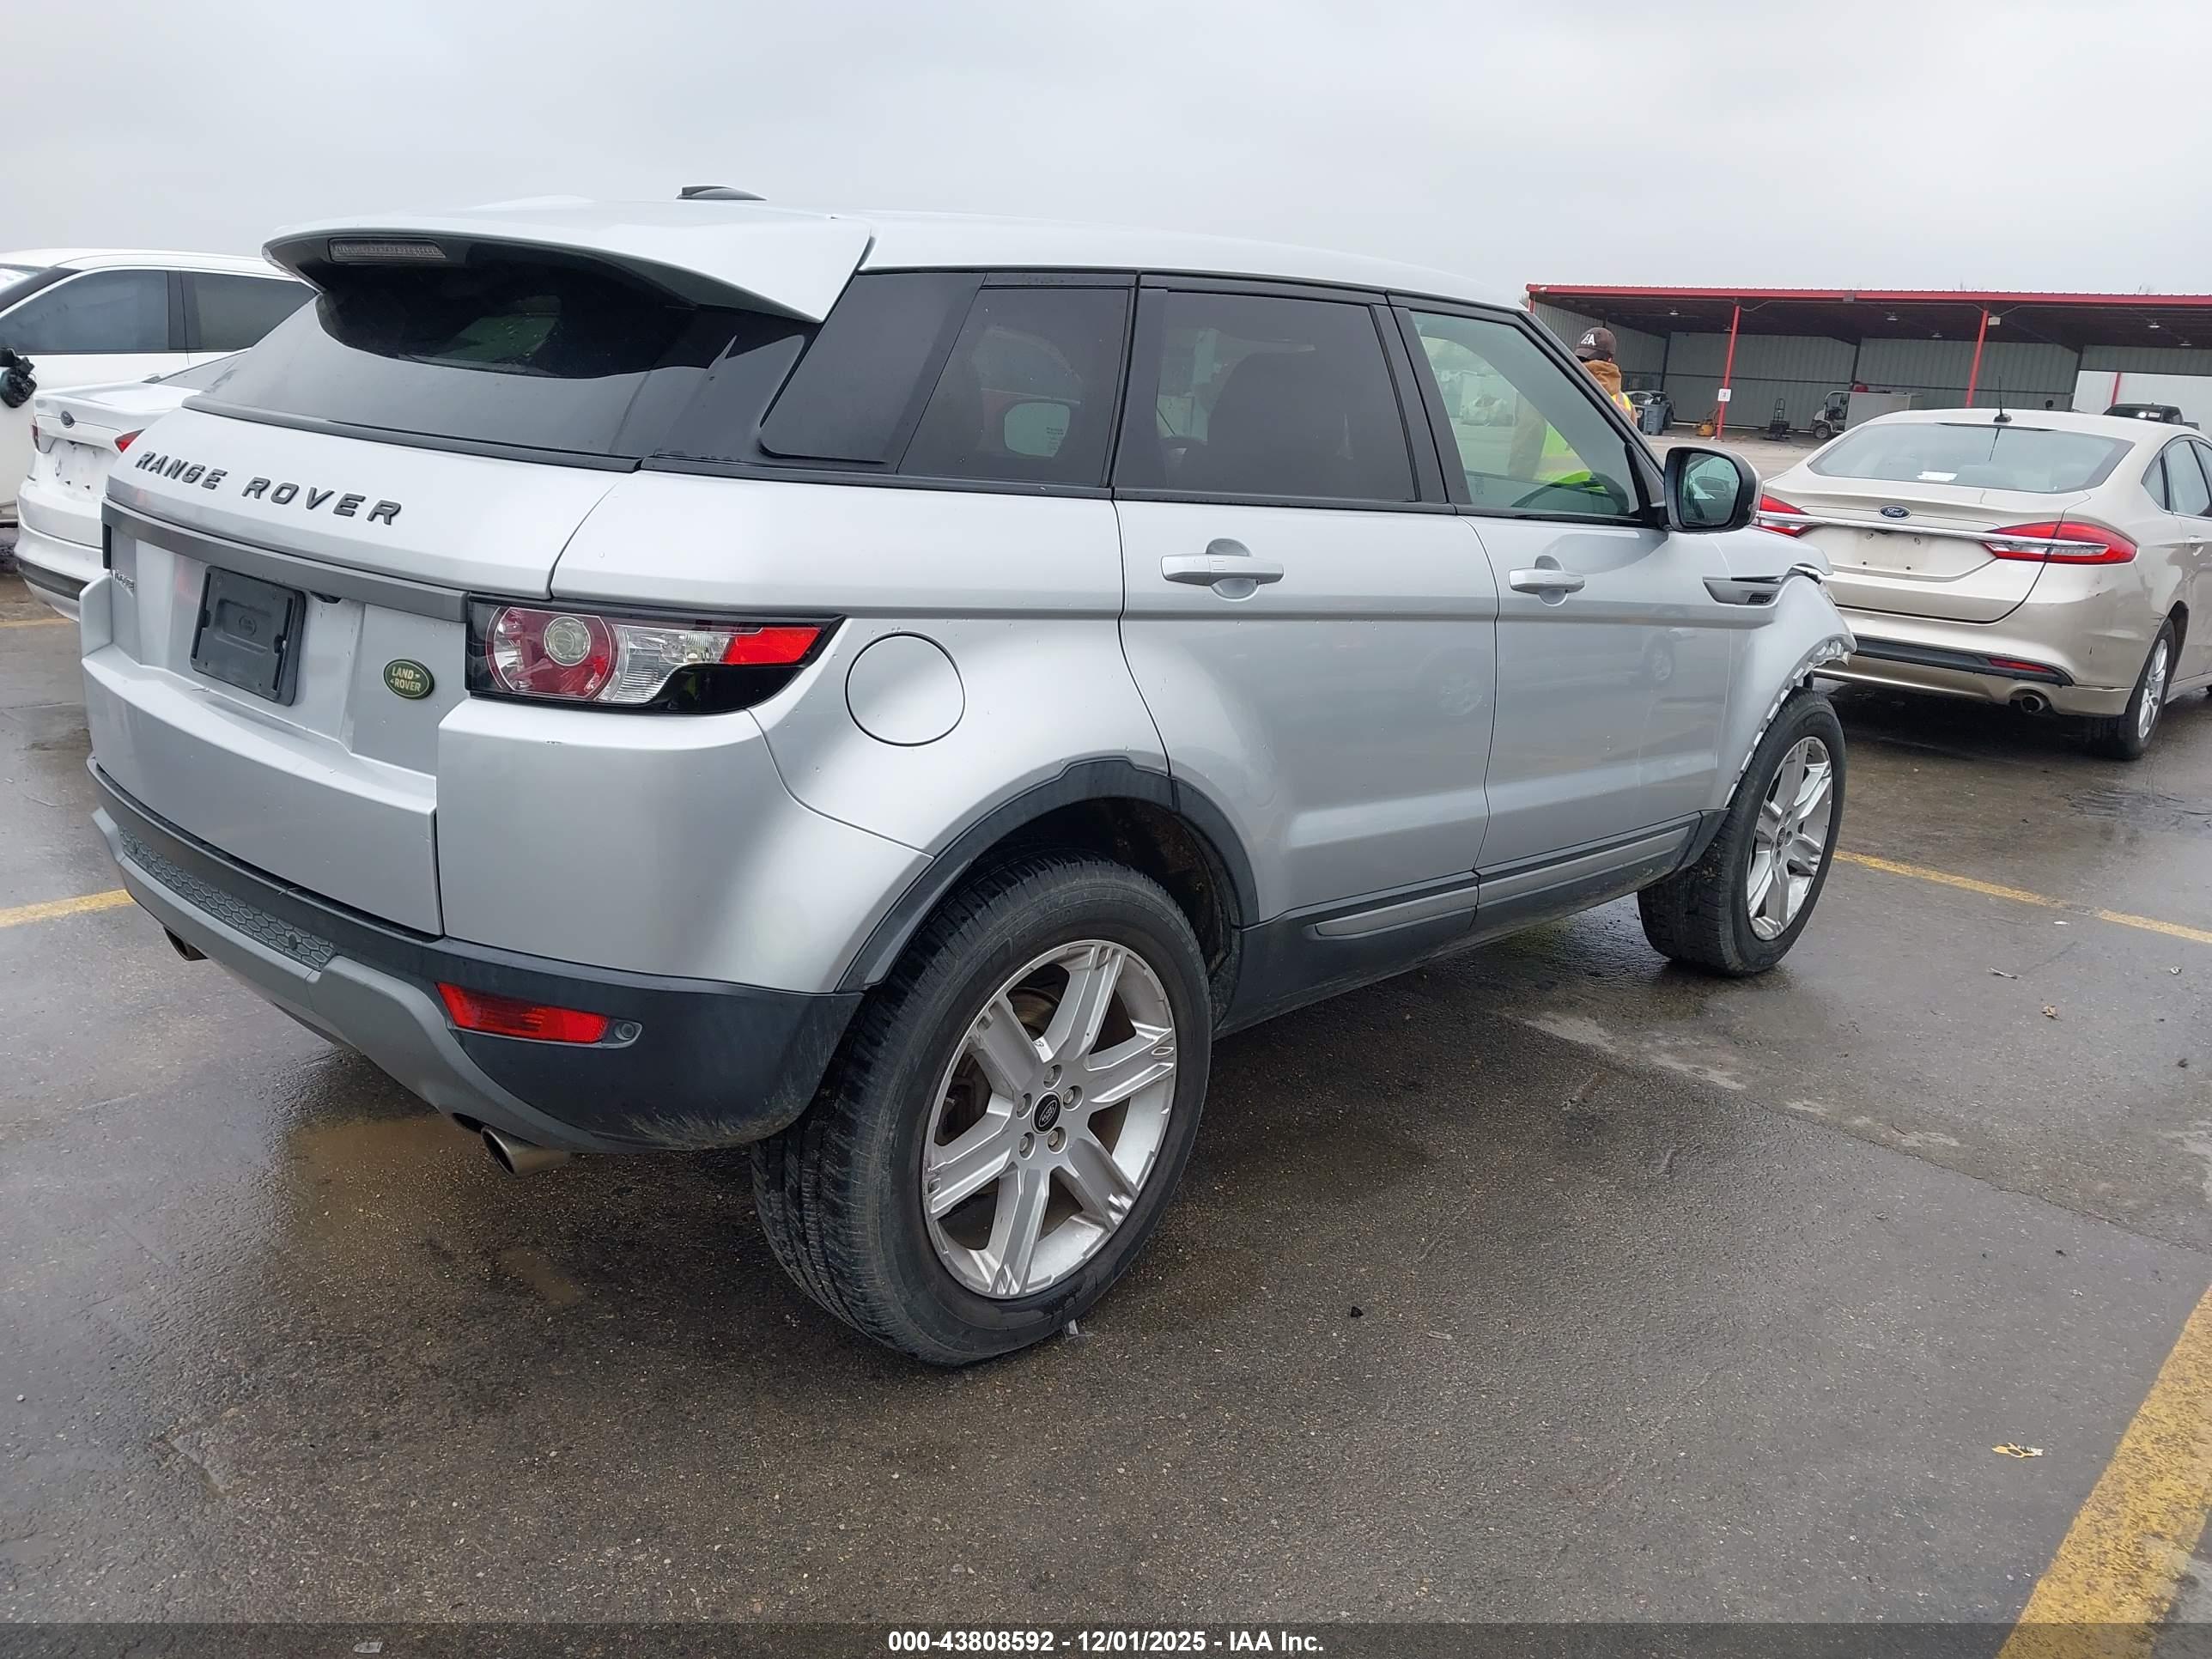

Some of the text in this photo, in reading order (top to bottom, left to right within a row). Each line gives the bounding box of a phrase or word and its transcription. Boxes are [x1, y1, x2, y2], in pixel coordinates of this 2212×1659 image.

[135, 450, 402, 526] RANGE ROVER
[392, 666, 414, 680] LAND
[394, 678, 422, 693] ROVER
